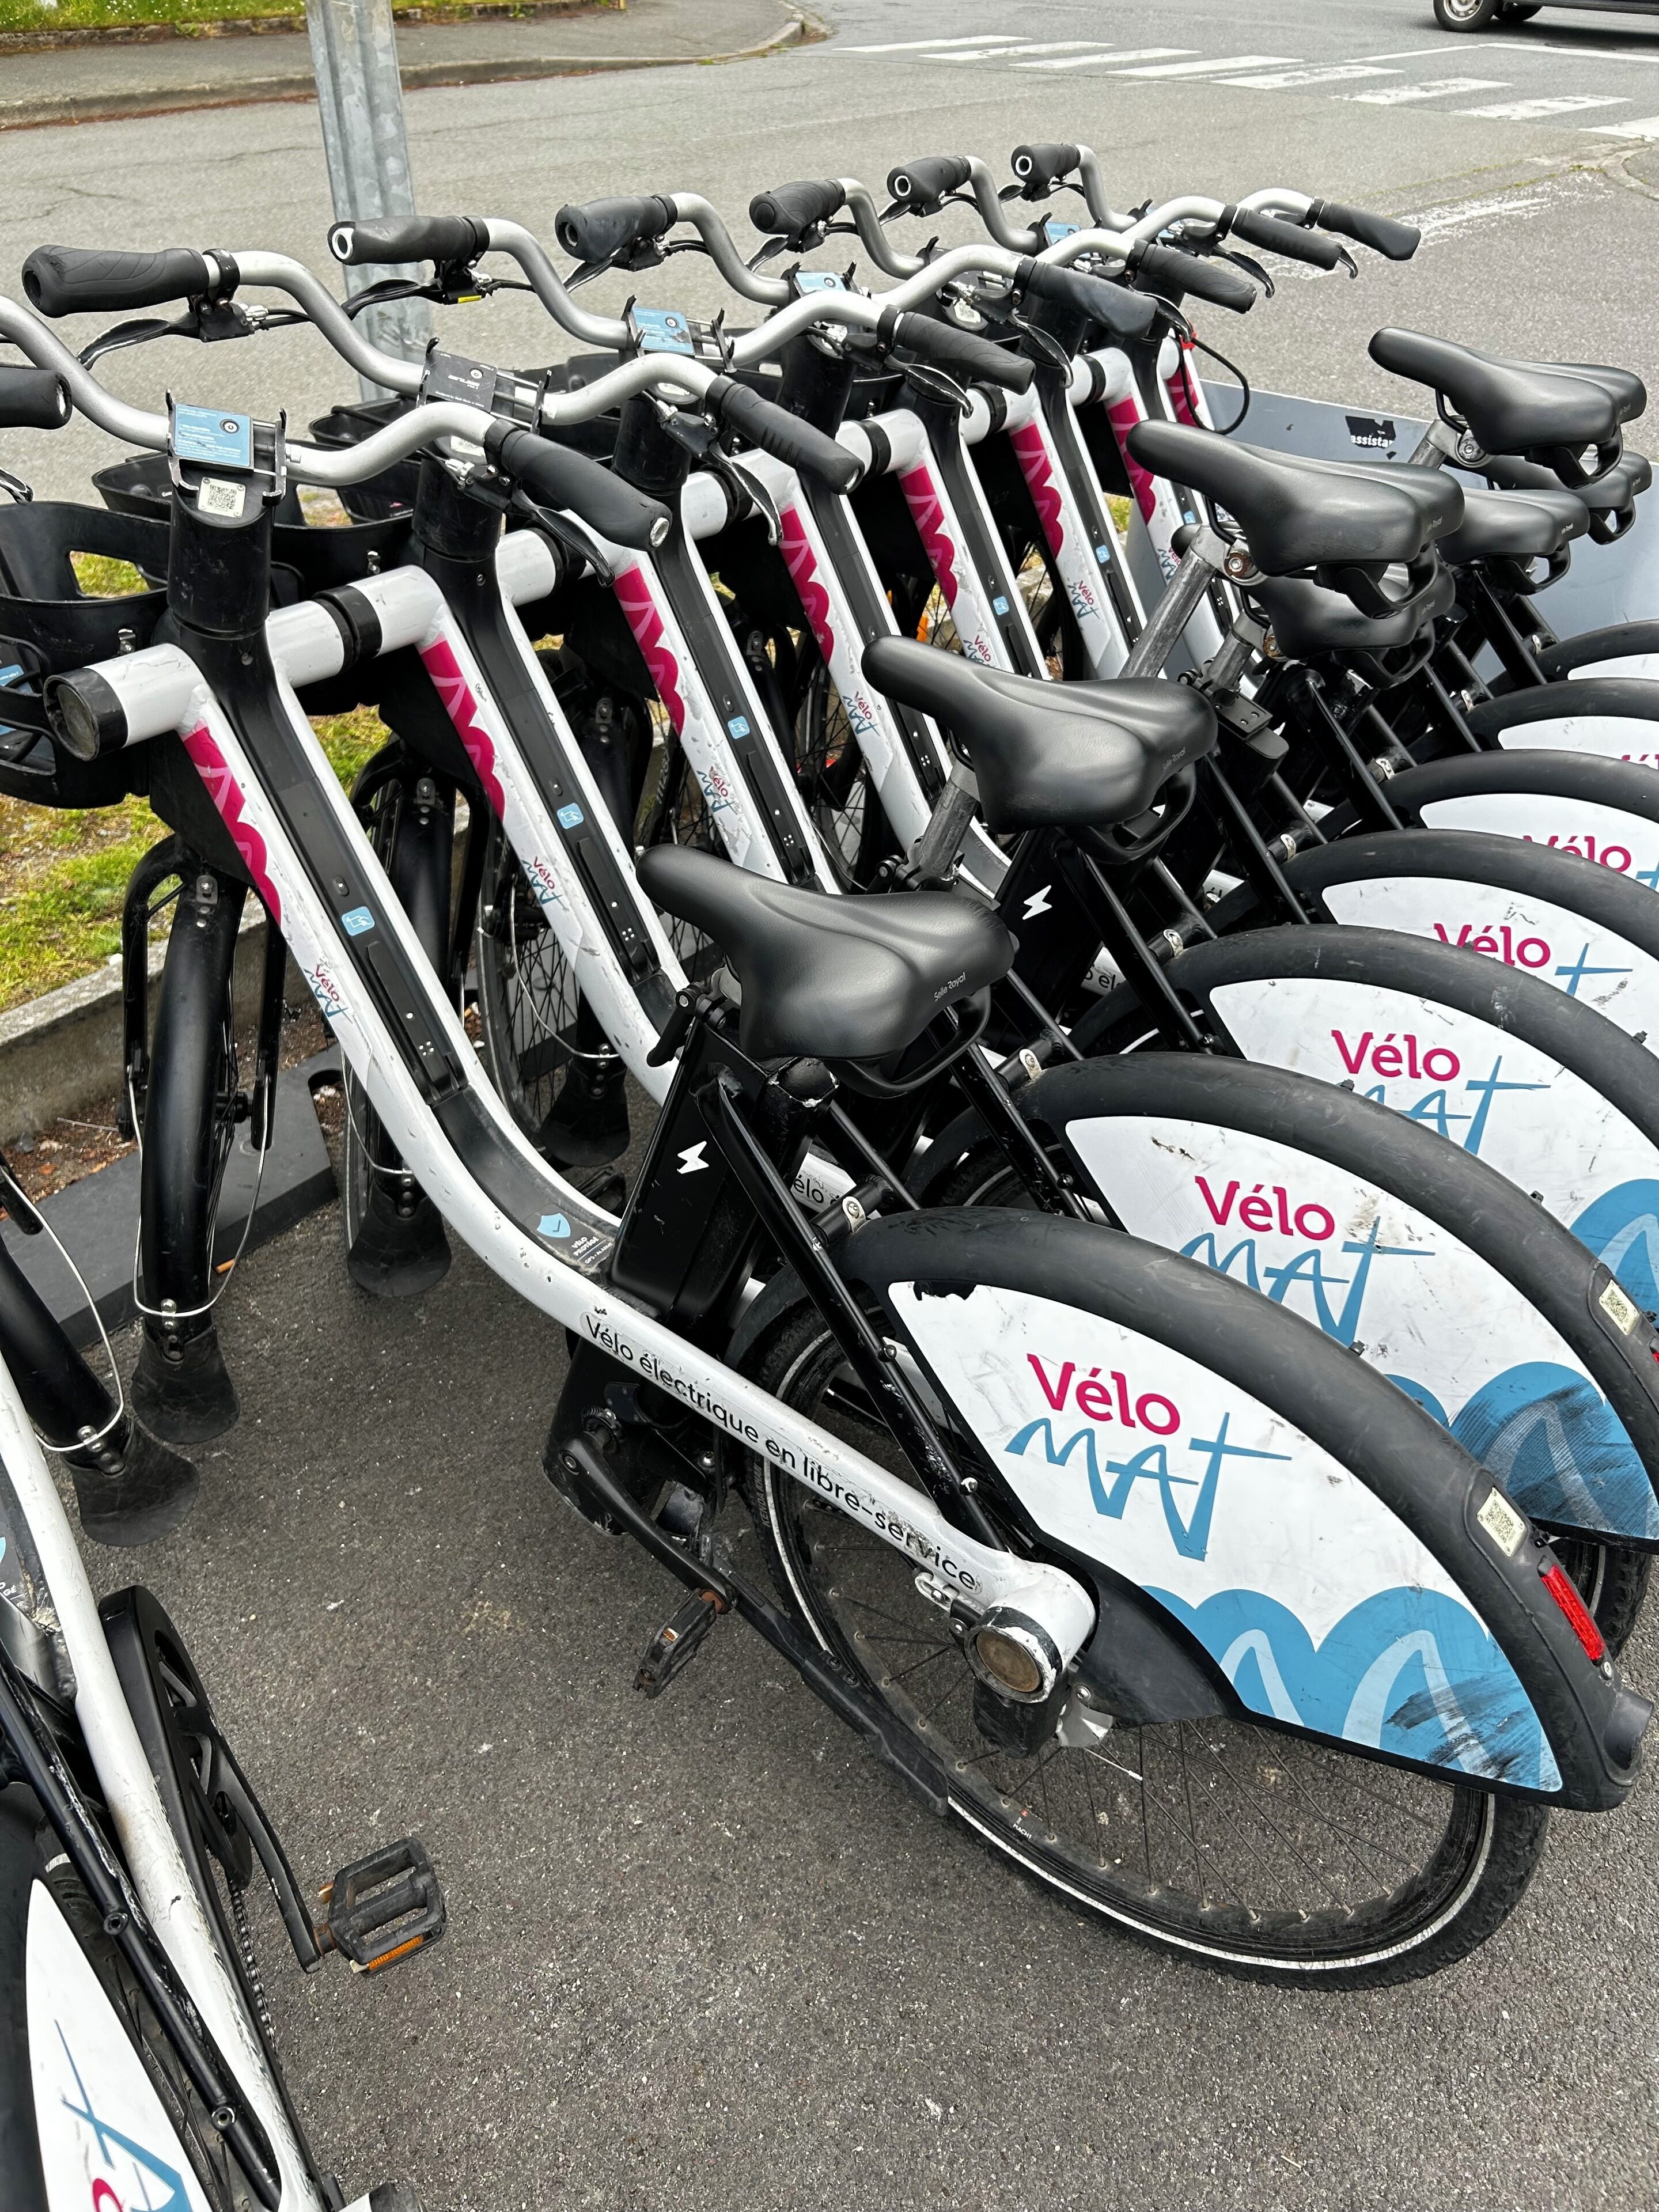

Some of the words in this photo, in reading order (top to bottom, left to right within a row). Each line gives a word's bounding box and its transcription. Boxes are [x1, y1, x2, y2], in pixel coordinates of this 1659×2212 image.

[933, 986, 948, 1002] Selle
[1330, 1029, 1461, 1082] Vélo
[793, 1174, 824, 1204] élo
[1194, 1175, 1336, 1241] Vélo
[1027, 1353, 1181, 1436] Vélo
[585, 1314, 634, 1363] Vélo
[639, 1351, 760, 1444] électrique
[765, 1438, 796, 1469] en
[802, 1453, 978, 1590] libre-service
